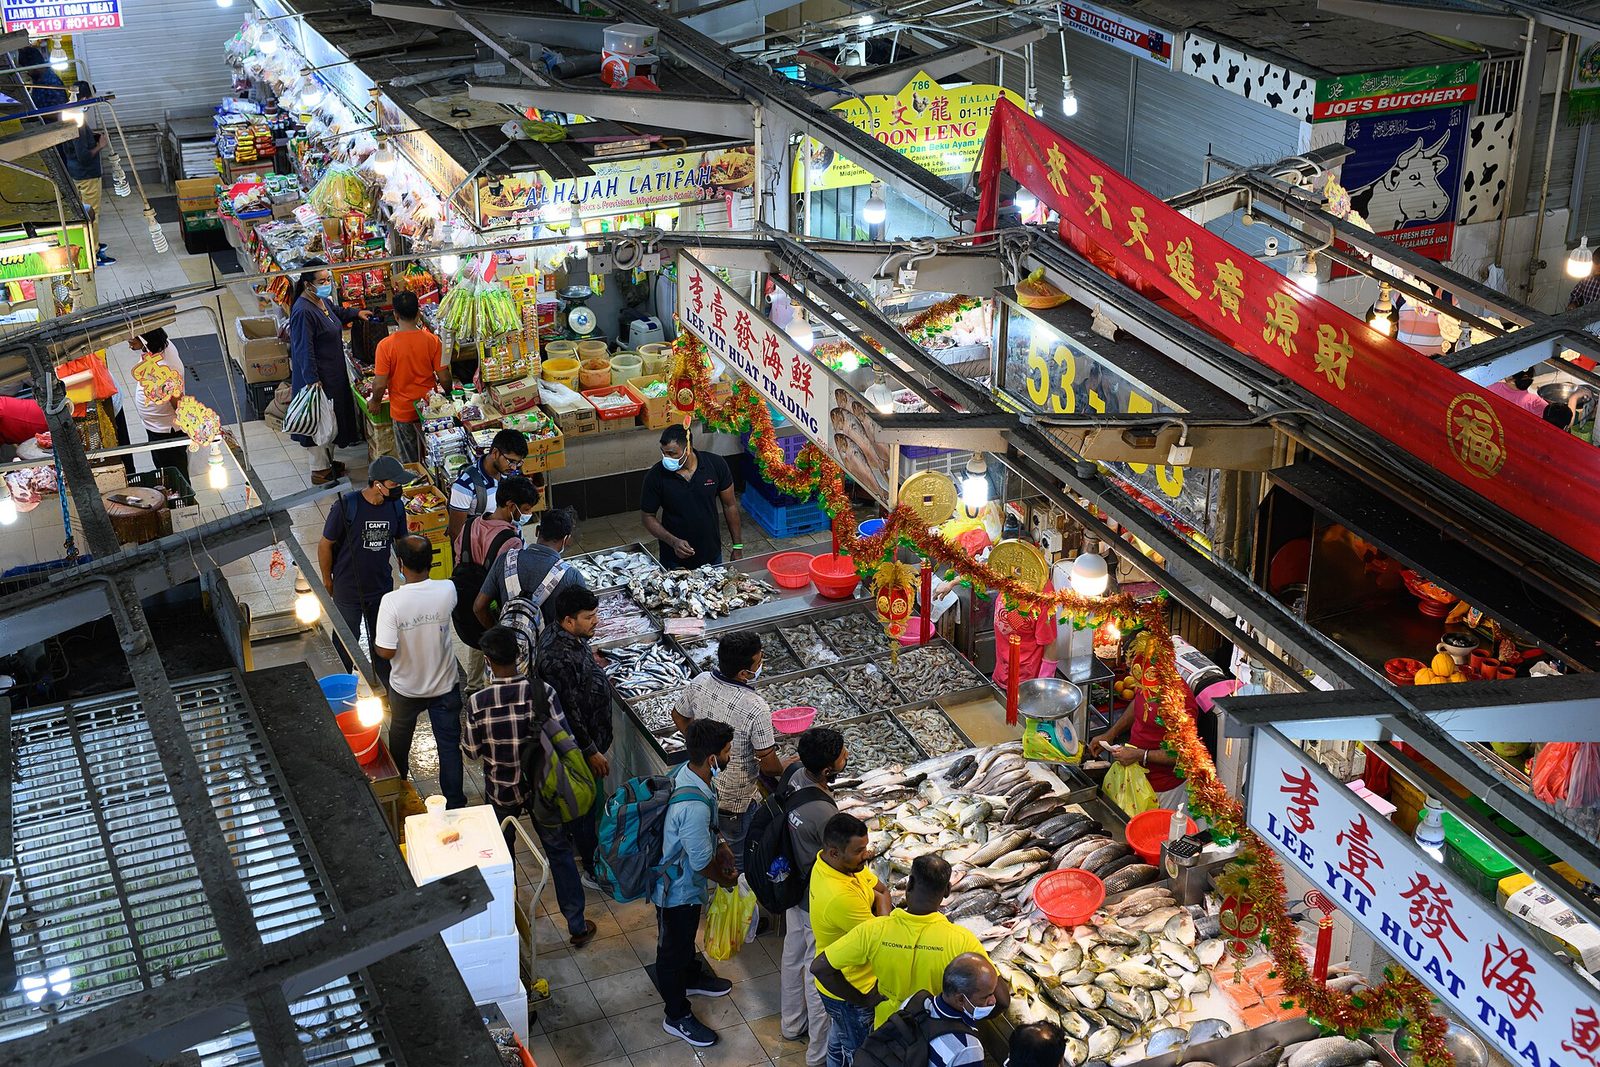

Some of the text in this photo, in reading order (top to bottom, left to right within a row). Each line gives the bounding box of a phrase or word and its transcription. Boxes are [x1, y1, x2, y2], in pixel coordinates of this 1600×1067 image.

[8, 8, 34, 20] LAMB
[35, 6, 61, 18] MEAT
[88, 2, 114, 14] MEAT
[1069, 20, 1088, 33] EXPECT
[1089, 29, 1100, 38] THE
[1080, 11, 1141, 43] BUTCHERY
[912, 80, 930, 92] 786
[889, 95, 952, 126] 文龍
[960, 94, 996, 105] HALAL
[1325, 88, 1467, 116] JOE'S BUTCHERY
[870, 121, 977, 146] OON LENG
[910, 145, 926, 153] Dan
[952, 139, 975, 149] Ayam
[629, 165, 711, 194] LATIFAH
[1400, 231, 1419, 241] FRESH
[1420, 228, 1436, 238] BEEF
[1435, 235, 1448, 244] USA
[686, 308, 819, 434] LEE YIT HUAT TRADING
[1452, 404, 1501, 472] 福
[1266, 812, 1314, 869] LEE
[1324, 861, 1373, 917] YIT
[1379, 911, 1467, 999] HUAT
[1476, 995, 1562, 1067] TRA
